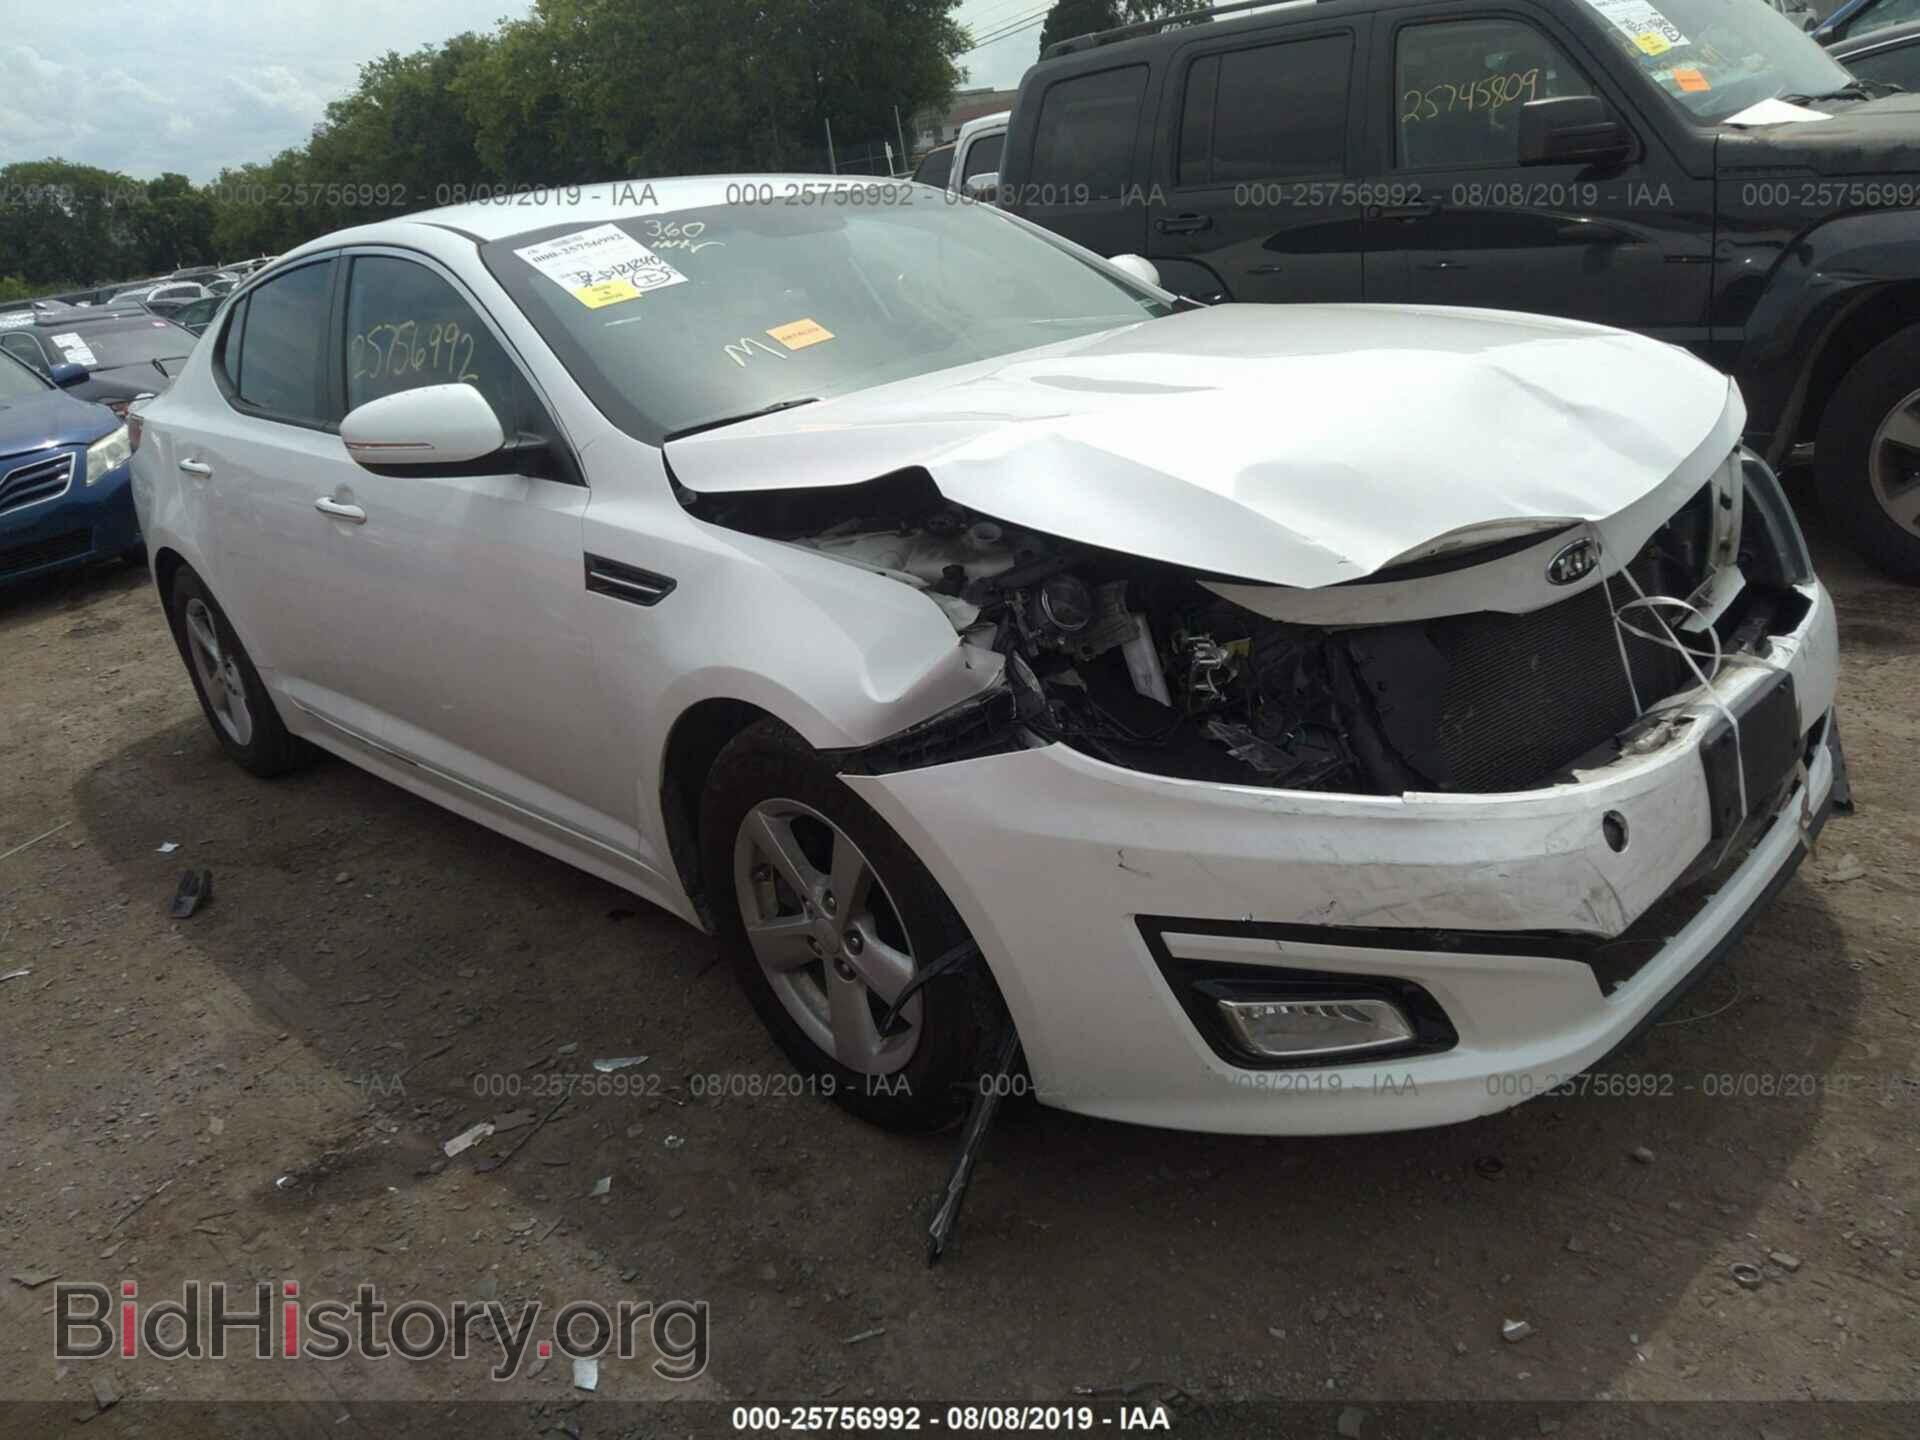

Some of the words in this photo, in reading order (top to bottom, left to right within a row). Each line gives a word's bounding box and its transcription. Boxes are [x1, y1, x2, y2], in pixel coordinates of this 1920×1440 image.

[1401, 68, 1539, 123] 25745809
[644, 220, 705, 238] 360
[351, 320, 479, 381] 25756992
[723, 338, 788, 368] M
